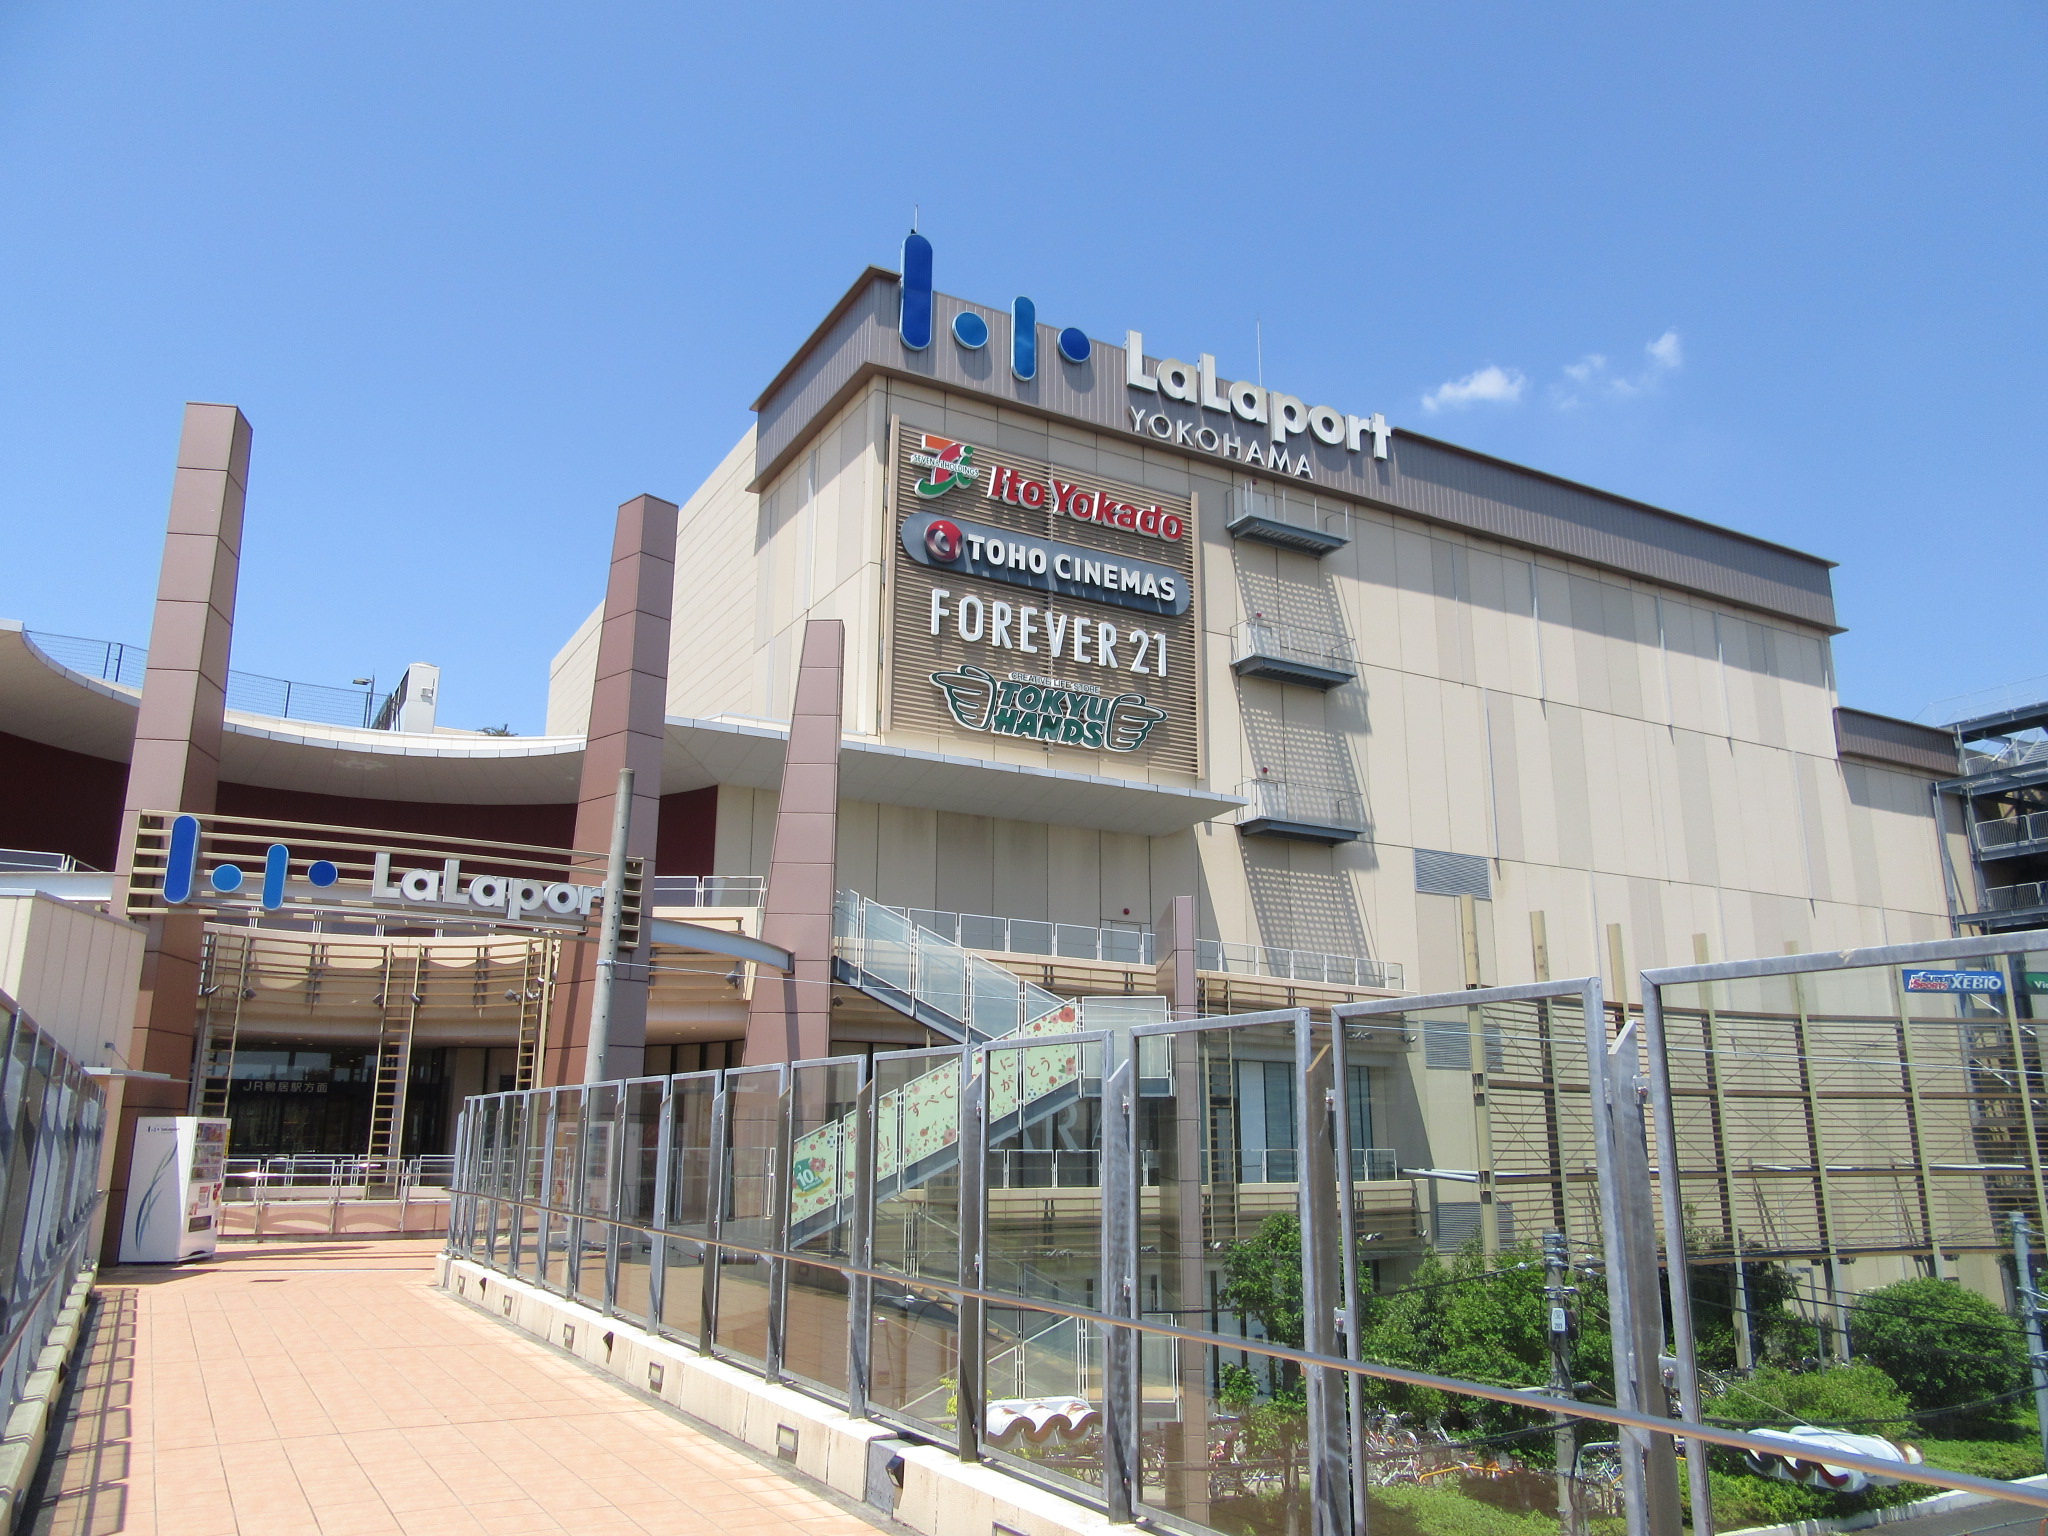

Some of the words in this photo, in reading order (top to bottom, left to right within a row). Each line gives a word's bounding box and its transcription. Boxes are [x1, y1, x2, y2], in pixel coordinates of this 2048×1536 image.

[1126, 328, 1393, 462] LaLaport
[1130, 405, 1314, 480] YOKOHAMA
[967, 533, 1048, 576] TOHO
[1052, 553, 1176, 603] CINEMAS
[930, 588, 1119, 670] FOREVER
[1128, 628, 1167, 678] 21
[996, 680, 1111, 724] TOKYU
[1010, 671, 1052, 687] CREATIVE
[1053, 678, 1072, 690] LIFE
[1073, 682, 1101, 695] STORE
[989, 706, 1106, 750] HANDS
[371, 851, 608, 921] LaLapor
[1951, 974, 2002, 990] XEBIO
